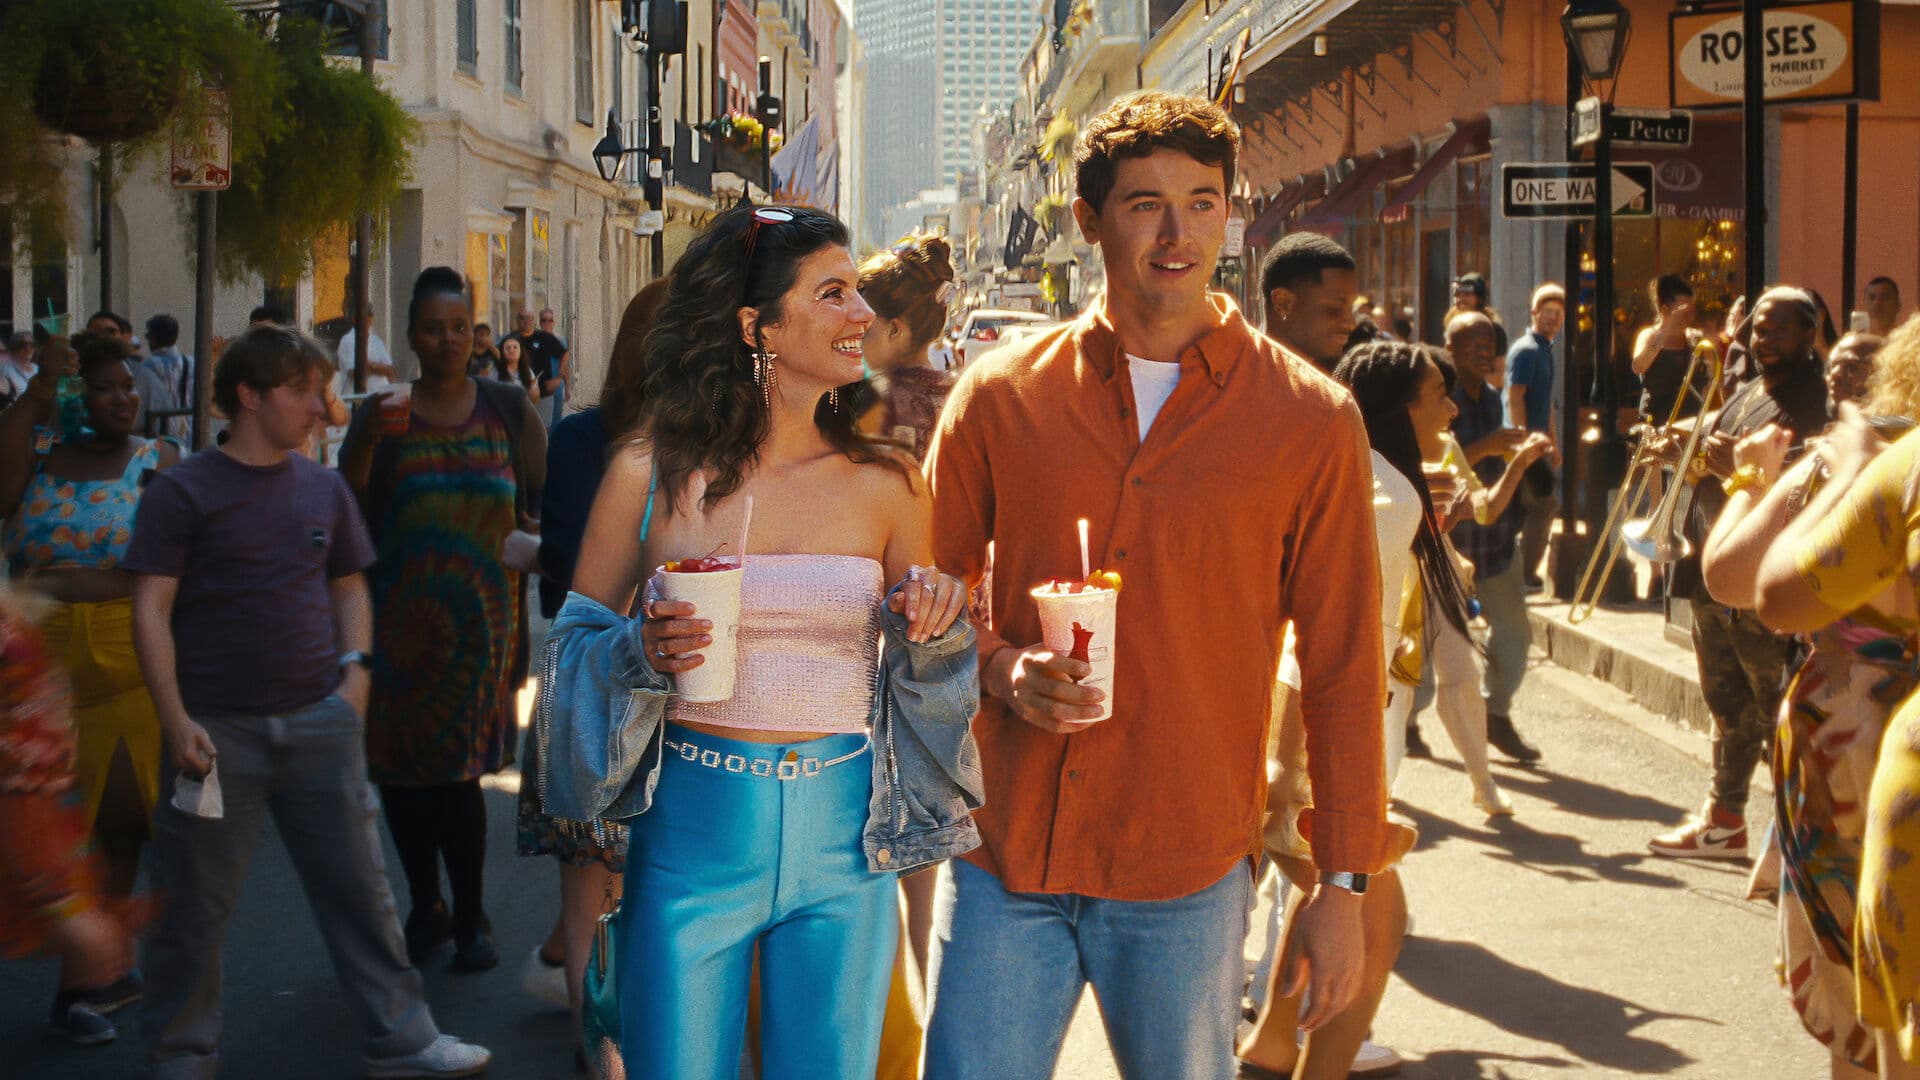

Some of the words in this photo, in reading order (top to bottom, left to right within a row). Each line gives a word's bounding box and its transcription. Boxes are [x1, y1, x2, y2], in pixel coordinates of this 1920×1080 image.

[1700, 24, 1816, 65] ROSES
[1770, 58, 1827, 74] MARKET
[1629, 119, 1687, 141] Peter
[1515, 180, 1557, 202] ONE
[1566, 180, 1596, 201] WA
